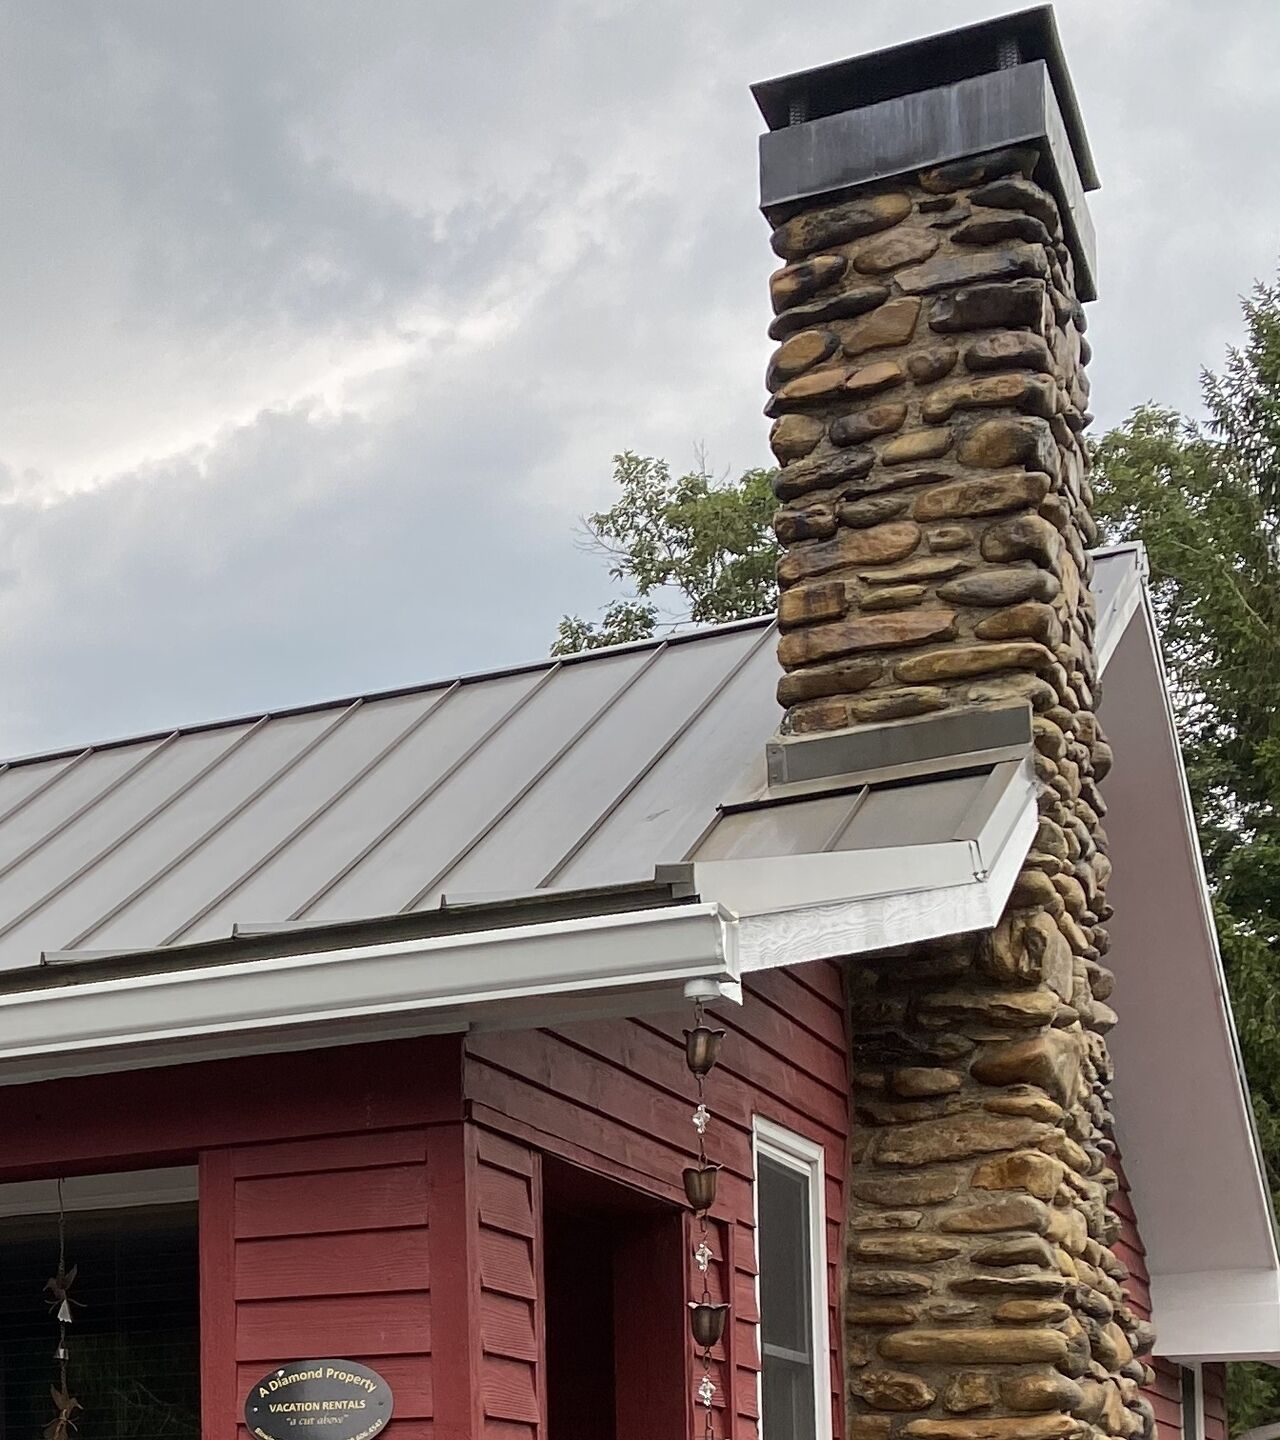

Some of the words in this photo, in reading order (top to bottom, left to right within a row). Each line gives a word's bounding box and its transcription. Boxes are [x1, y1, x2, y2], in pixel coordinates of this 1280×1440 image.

[258, 1387, 270, 1399] A
[269, 1367, 324, 1392] Diamond
[326, 1367, 378, 1394] Property
[268, 1401, 320, 1413] VACATION
[322, 1399, 366, 1411] RENTALS
